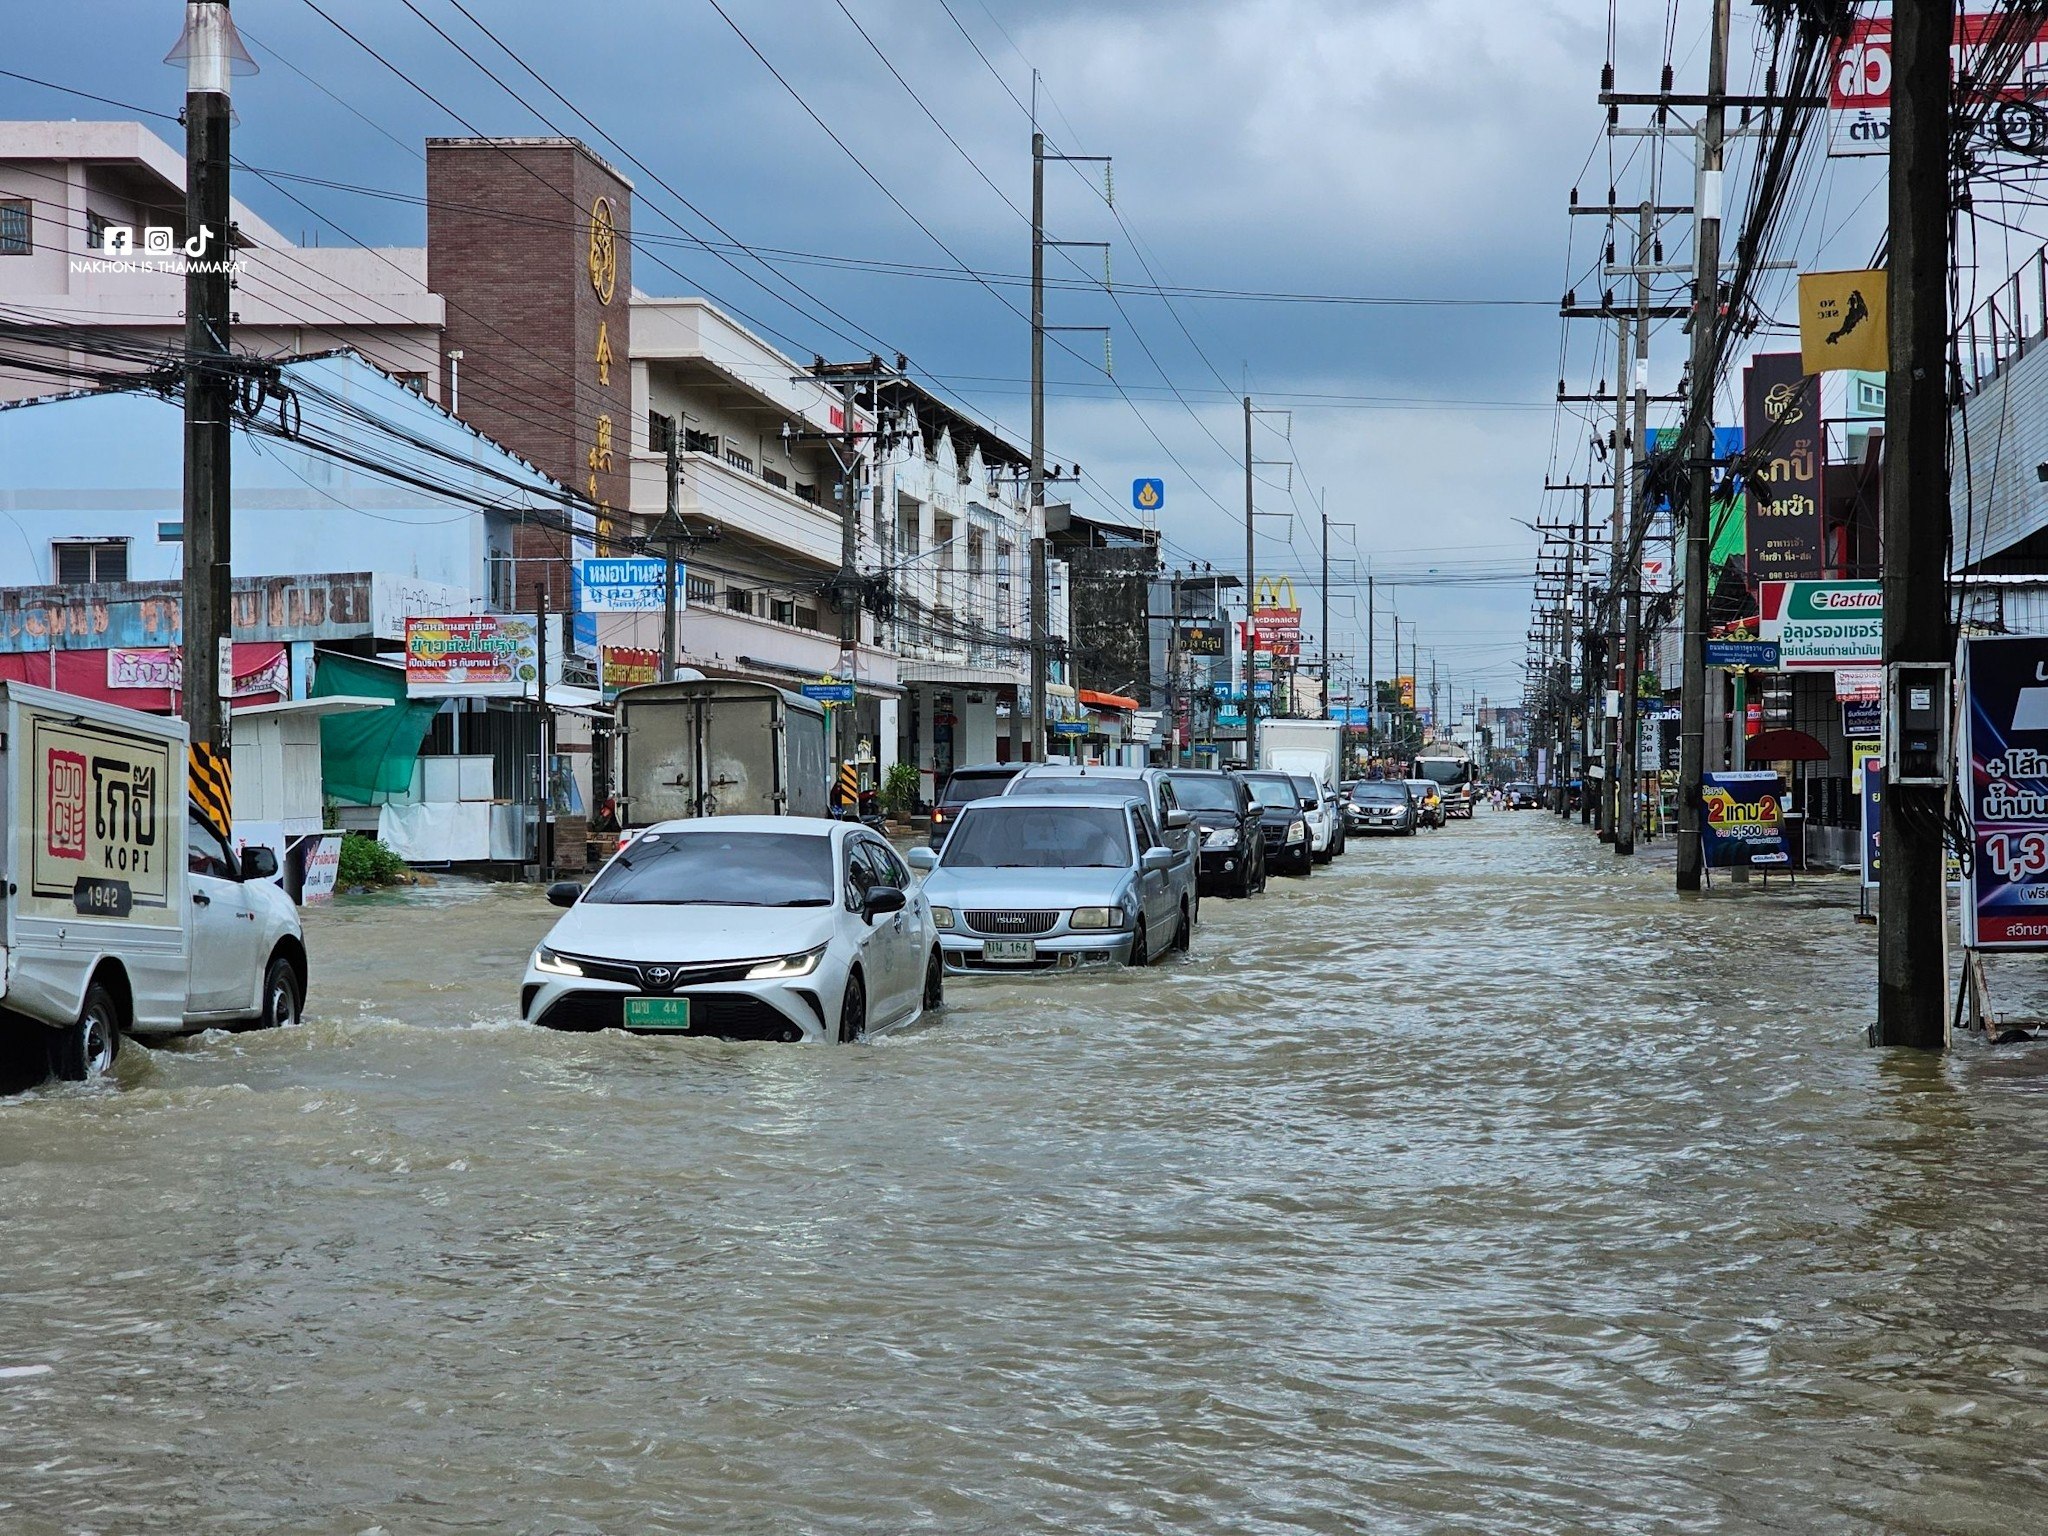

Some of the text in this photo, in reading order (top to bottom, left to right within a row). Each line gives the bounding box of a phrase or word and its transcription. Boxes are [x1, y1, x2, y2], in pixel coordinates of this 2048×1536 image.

[1764, 650, 1774, 659] 41
[448, 659, 458, 668] 15
[459, 658, 490, 668] กันยายน
[1732, 824, 1762, 840] 5,500
[105, 845, 149, 873] KOPI
[87, 885, 118, 908] 1942
[1010, 943, 1027, 954] 164
[663, 1001, 678, 1015] 44
